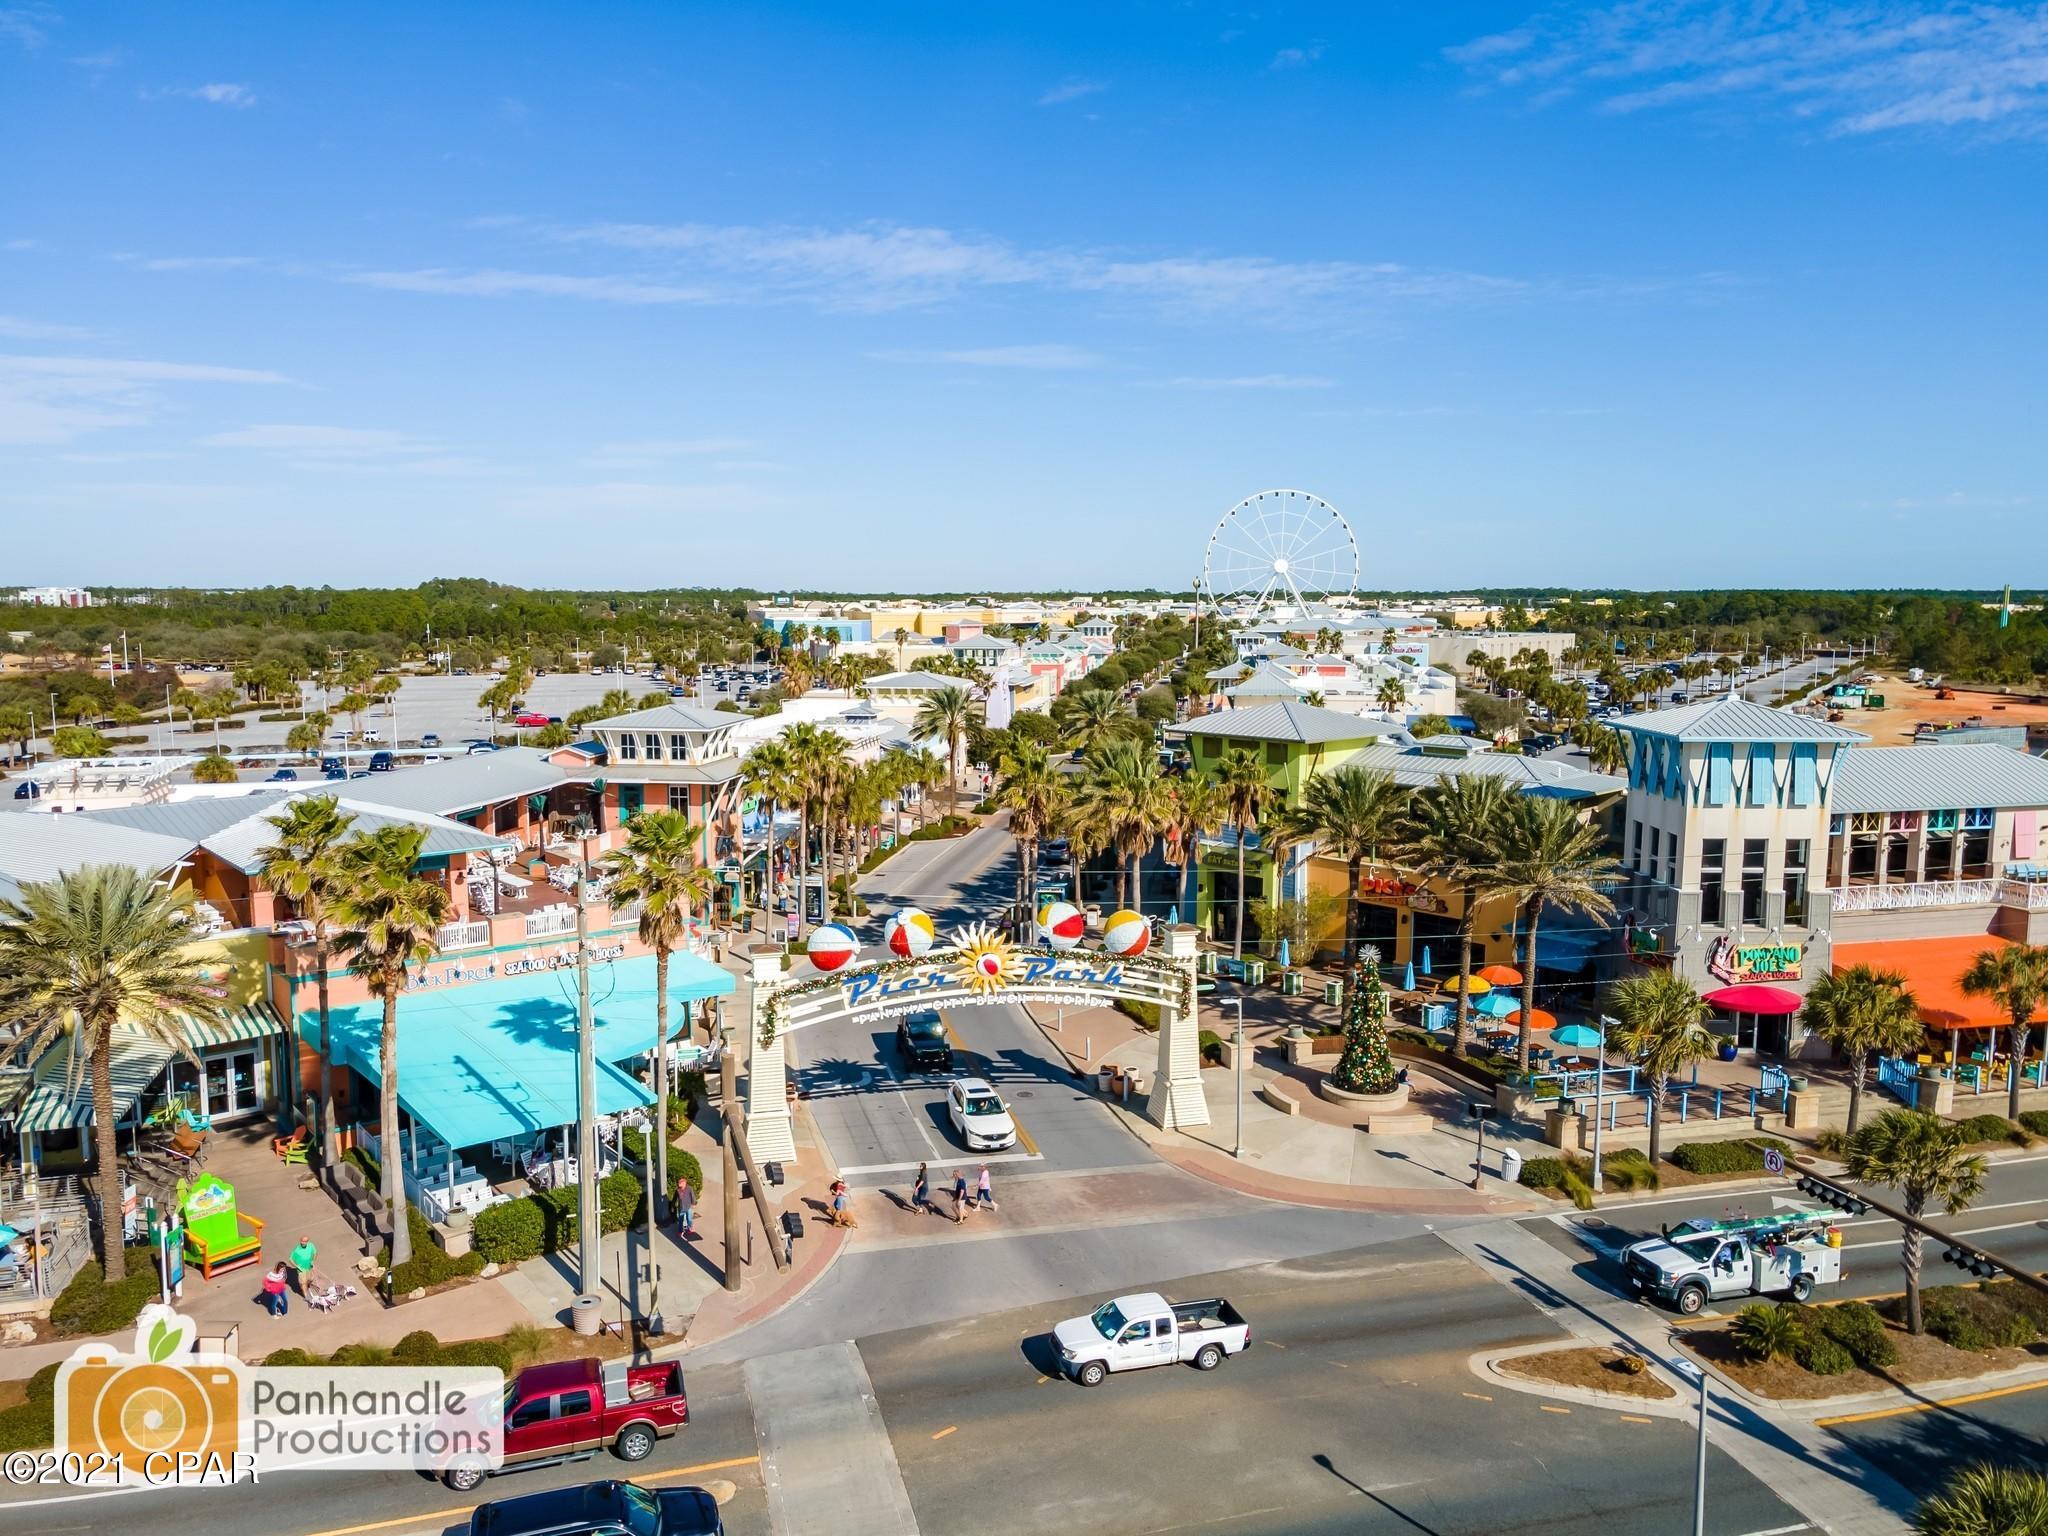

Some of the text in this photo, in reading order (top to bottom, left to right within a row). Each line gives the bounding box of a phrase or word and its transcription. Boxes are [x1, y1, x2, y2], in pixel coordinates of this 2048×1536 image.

[505, 958, 546, 976] SEAFOOD
[559, 950, 593, 966] OYSTR
[594, 944, 625, 962] HOUSE
[1772, 970, 1798, 980] HOUSE
[842, 957, 1125, 1006] Pier Park
[859, 993, 1109, 1025] PANAMA CITY BEACH FLORIDA
